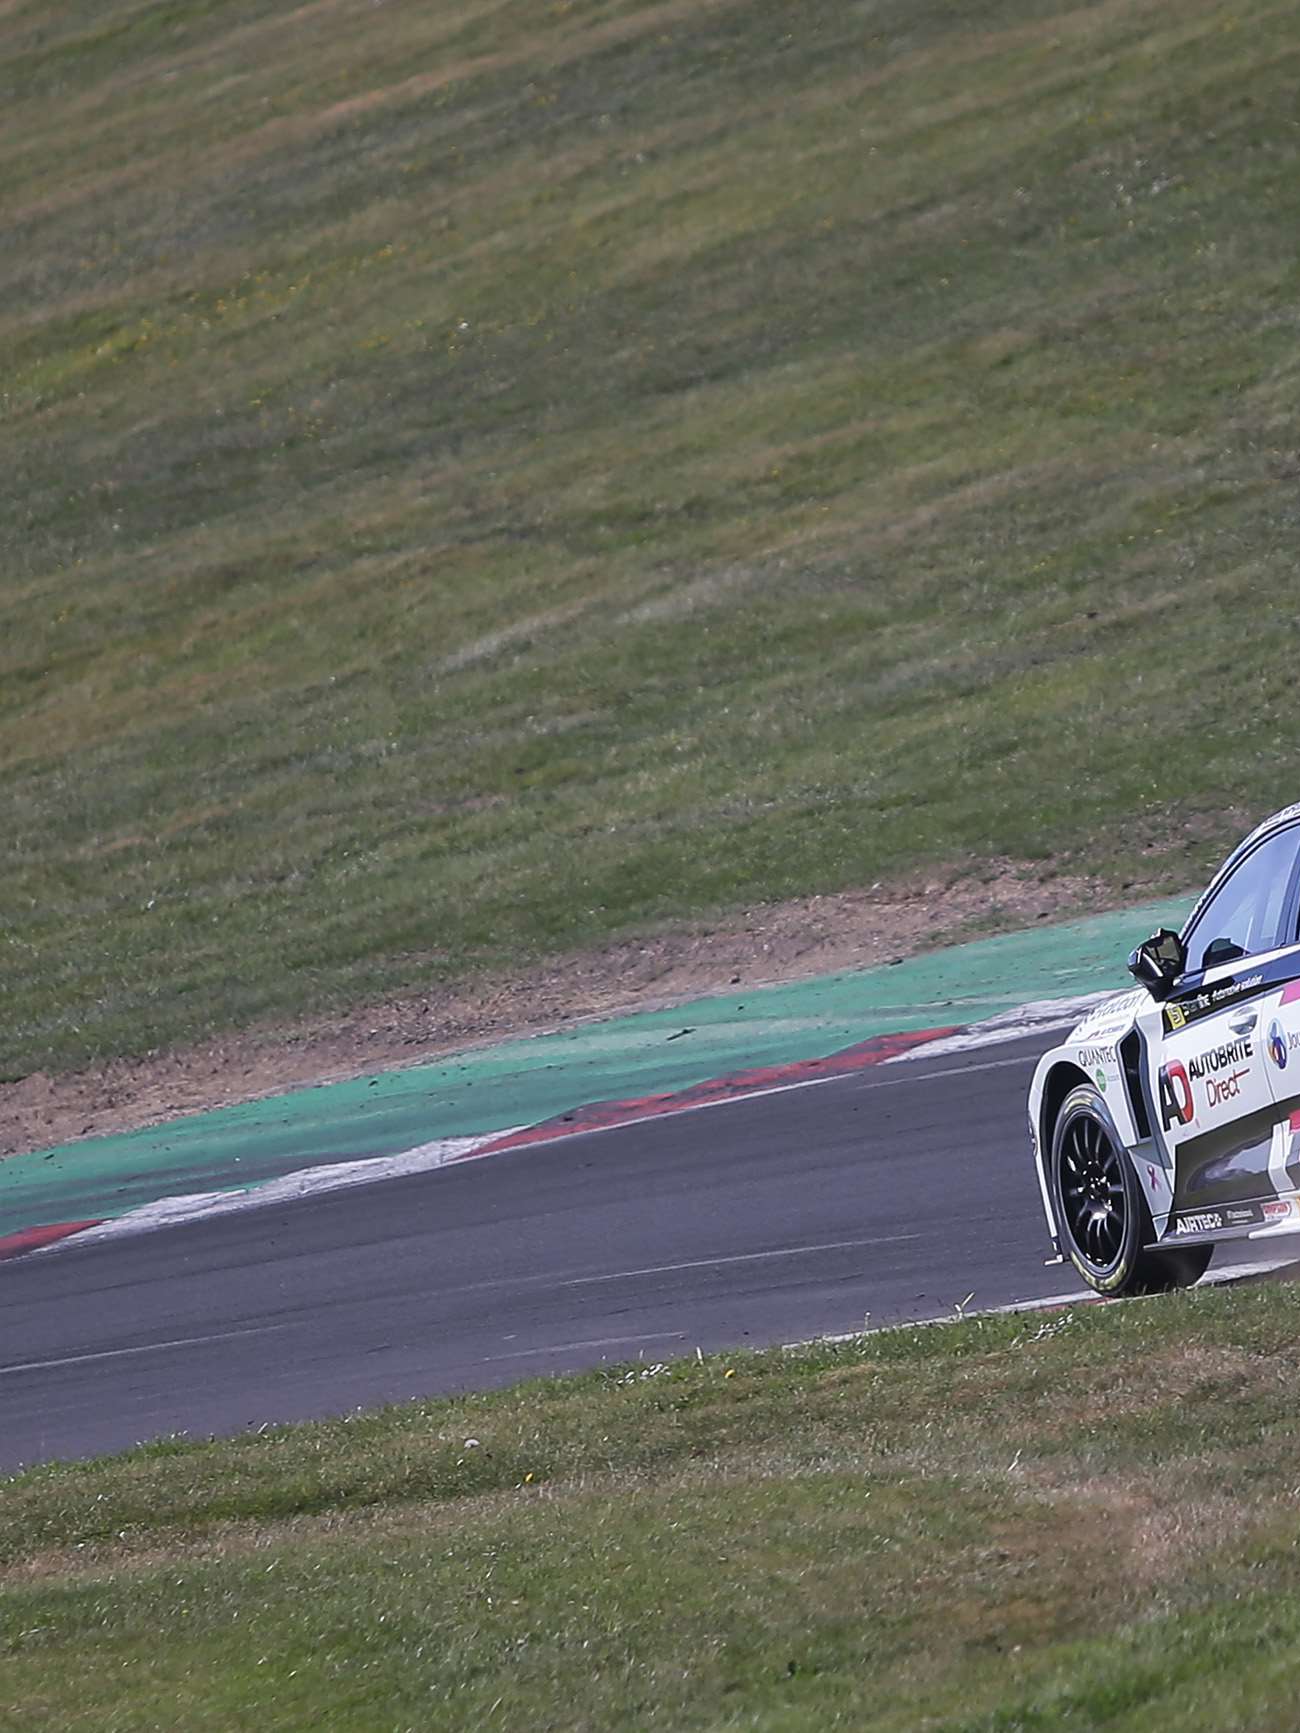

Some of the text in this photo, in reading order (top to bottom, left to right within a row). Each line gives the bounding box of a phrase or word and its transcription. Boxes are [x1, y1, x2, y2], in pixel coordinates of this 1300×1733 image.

[1078, 1046, 1118, 1067] QUANTEC
[1188, 1035, 1254, 1082] AUTOBRITE
[1158, 1059, 1194, 1132] AD
[1206, 1069, 1250, 1107] Direct
